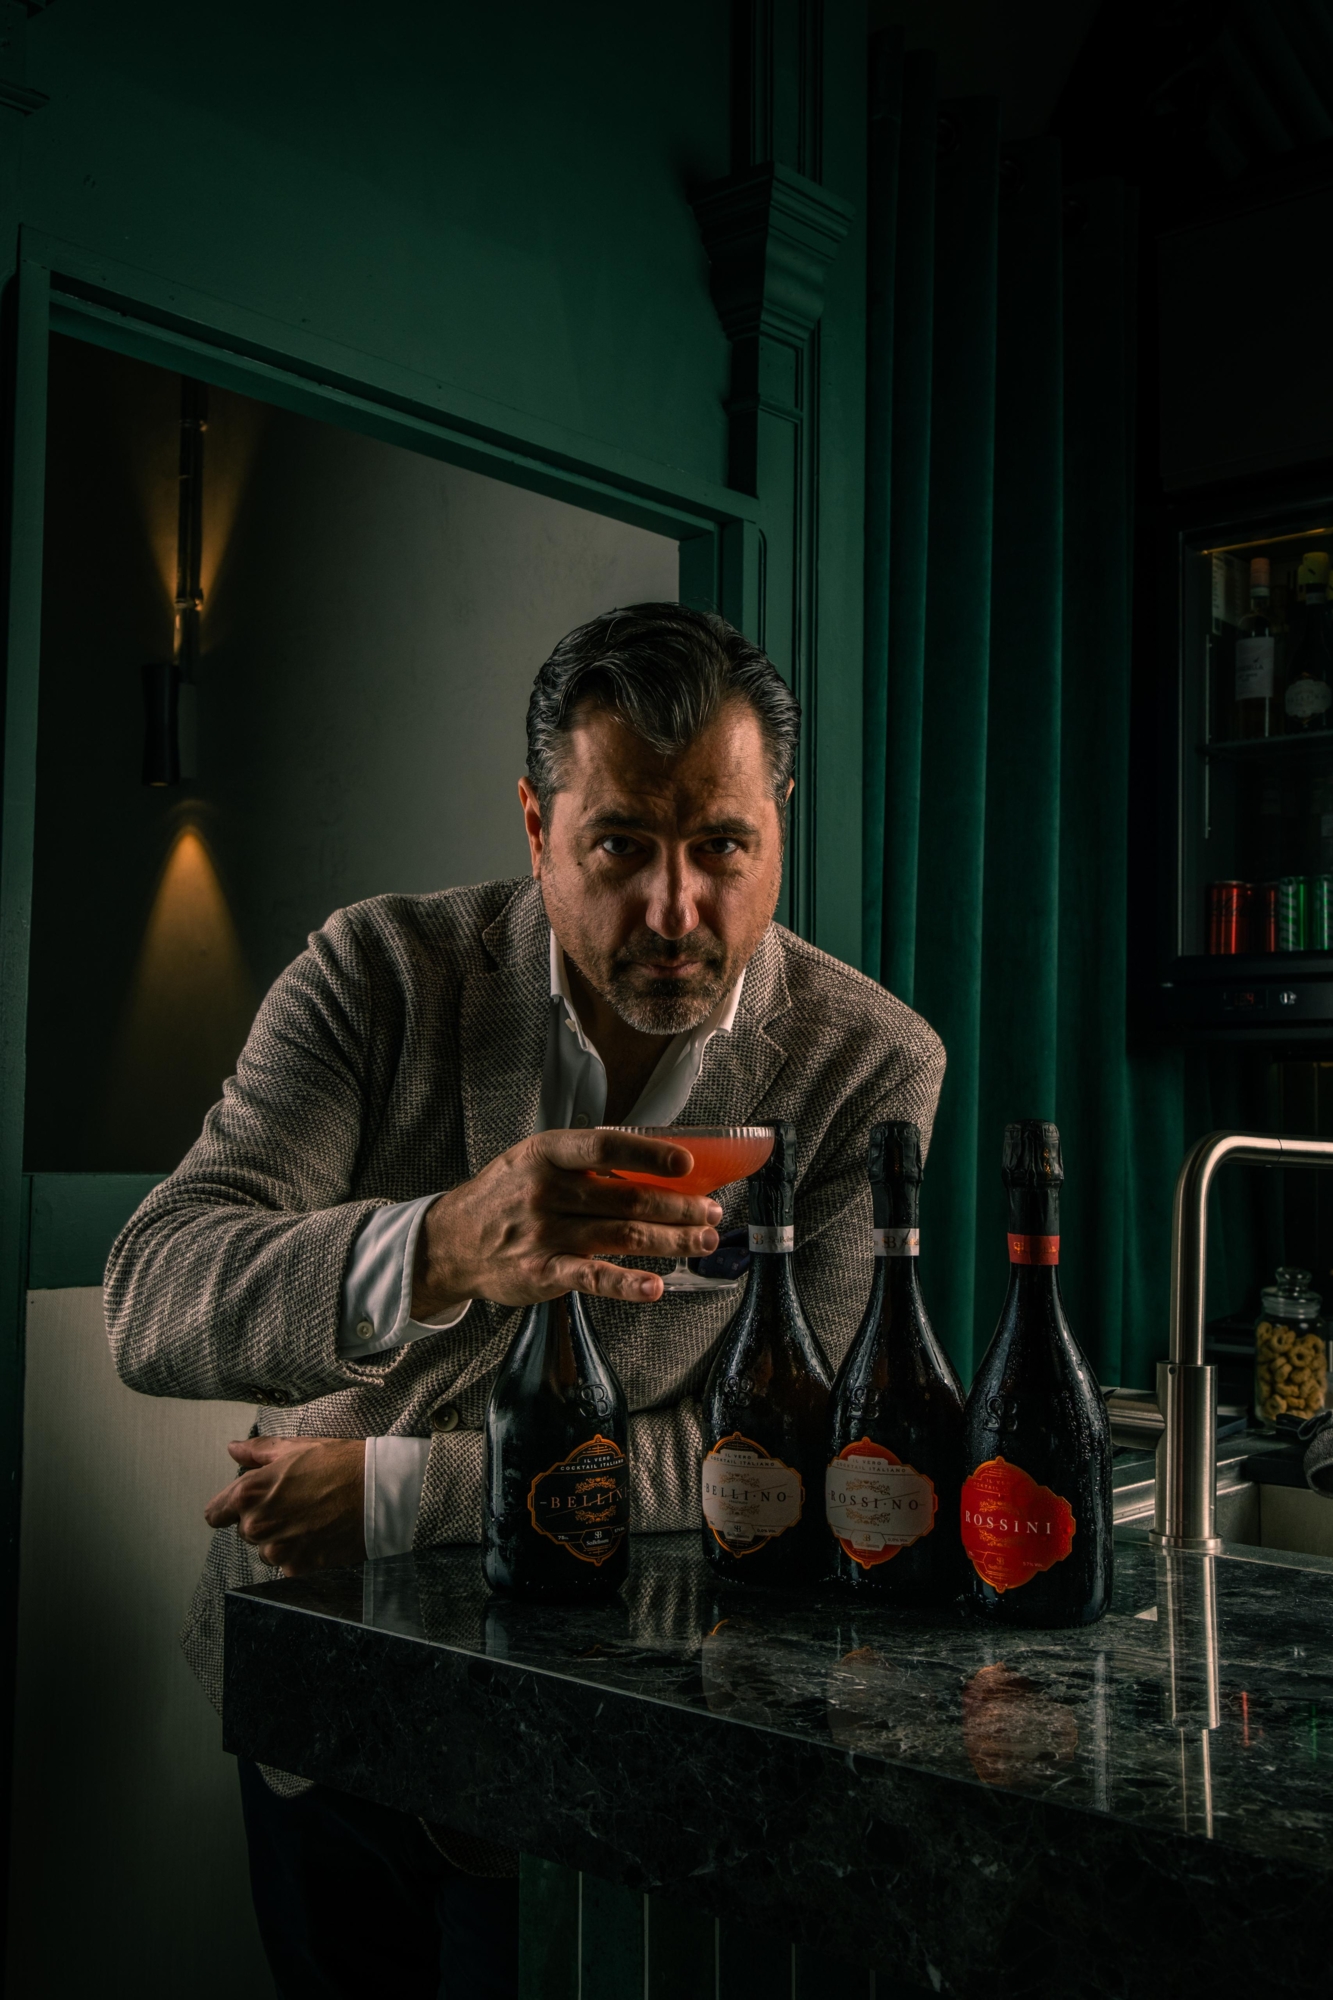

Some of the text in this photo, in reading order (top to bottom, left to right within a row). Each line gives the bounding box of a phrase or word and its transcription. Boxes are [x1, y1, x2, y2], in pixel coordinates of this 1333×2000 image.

[1278, 876, 1304, 953] prite
[600, 1459, 624, 1468] ITALIANO
[710, 1455, 737, 1465] COCKTAIL
[836, 1462, 866, 1471] COCKTAIL
[965, 1510, 1051, 1535] ROSSINI
